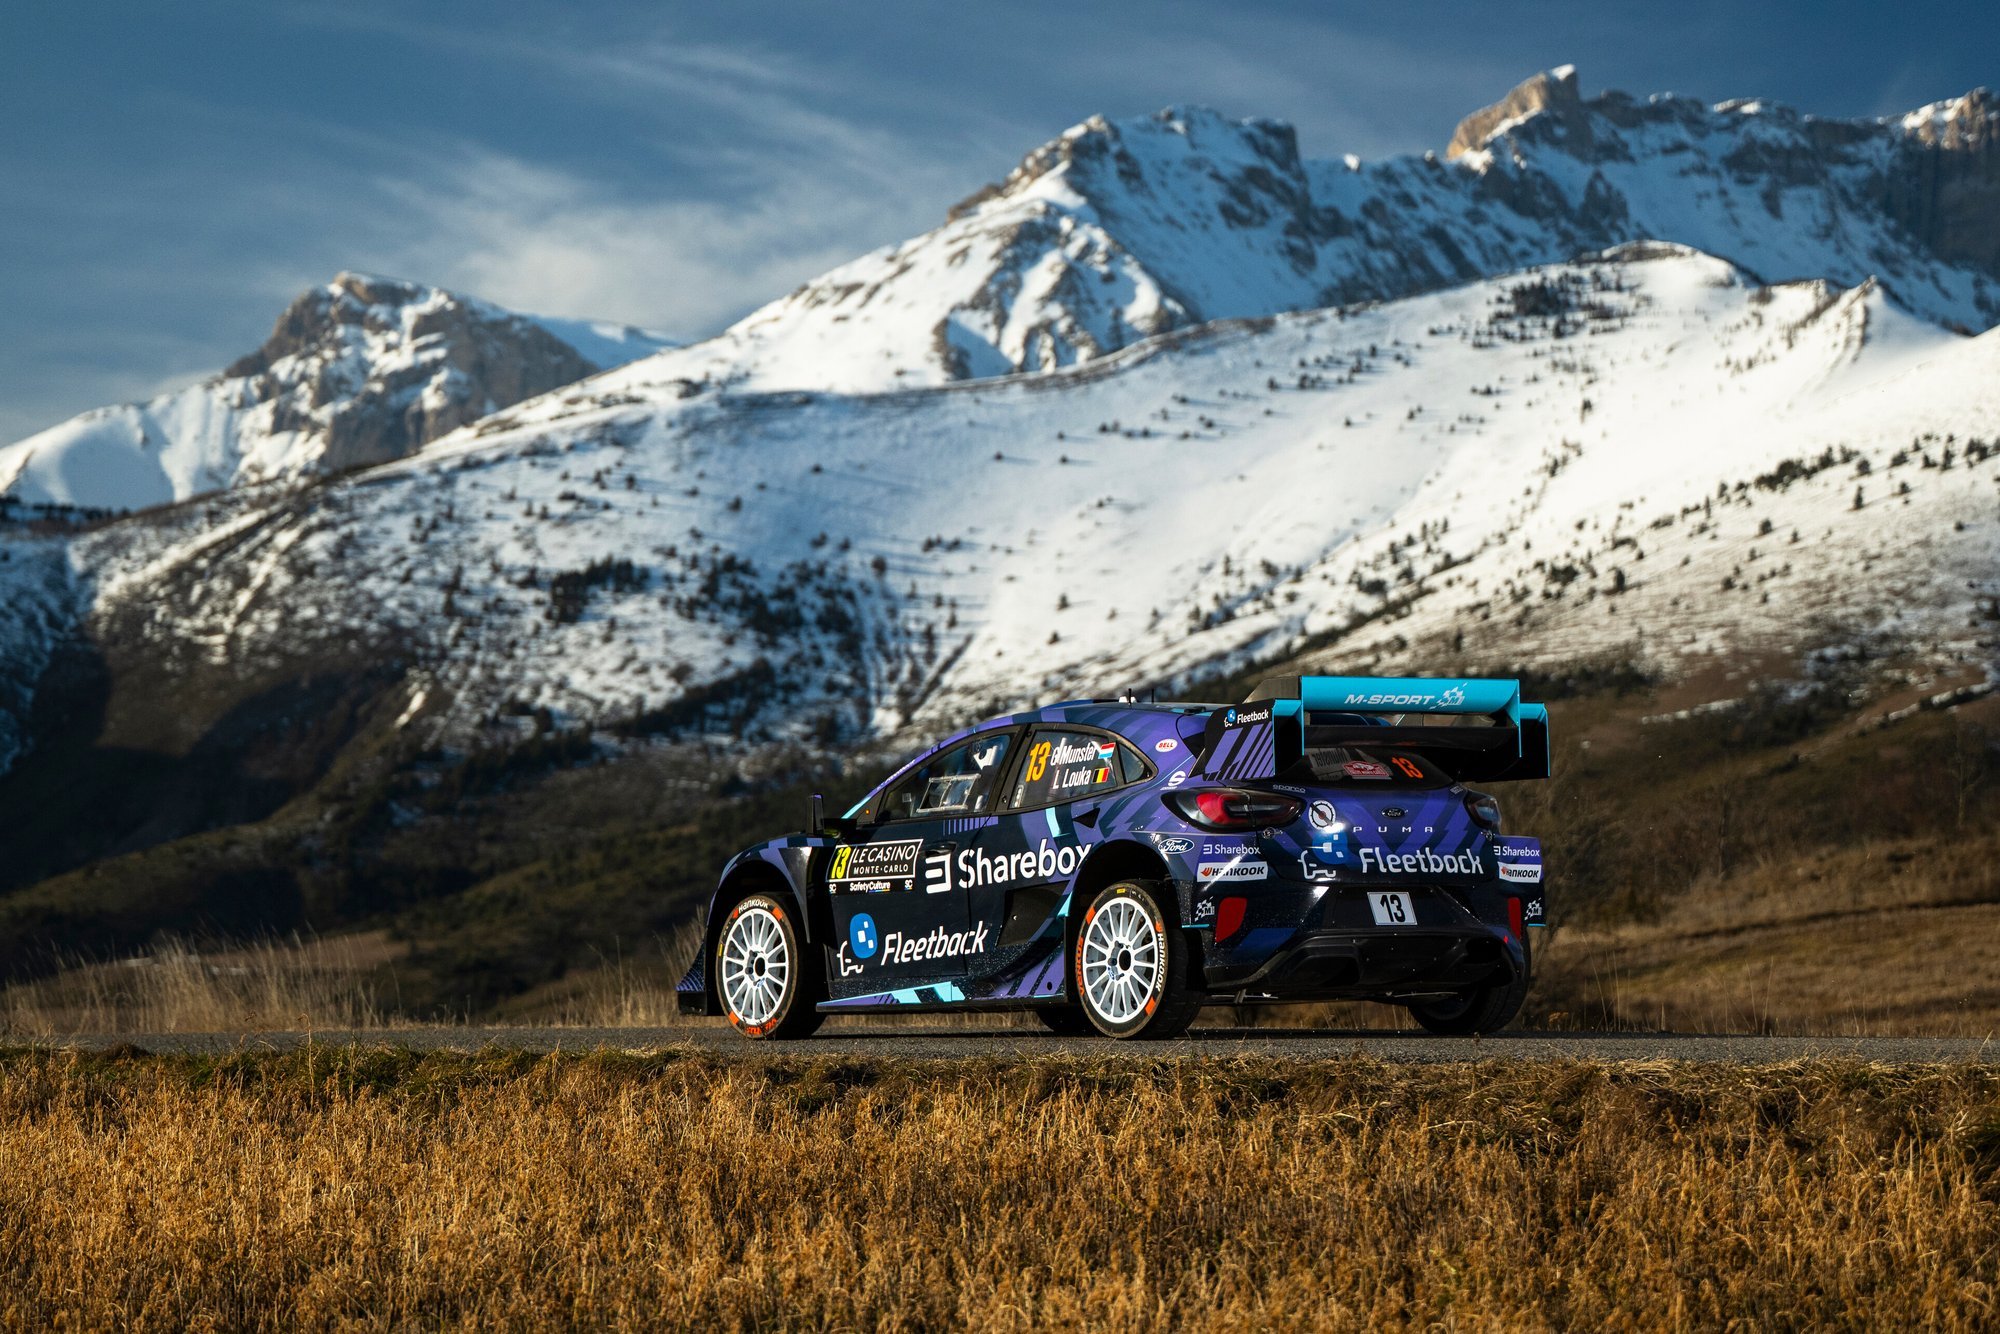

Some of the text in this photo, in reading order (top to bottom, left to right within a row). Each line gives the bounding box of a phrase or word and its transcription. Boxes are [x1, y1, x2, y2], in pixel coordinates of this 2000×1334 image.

[1344, 694, 1435, 705] M-SPORT
[1236, 709, 1269, 725] Fleetback
[1025, 741, 1052, 783] 13
[1391, 756, 1424, 779] 13
[1062, 766, 1092, 788] Louka
[852, 844, 916, 864] LE CASINO
[1163, 840, 1188, 854] Ford
[1214, 843, 1261, 855] Sharebox
[1502, 846, 1540, 857] Sharebox
[830, 846, 852, 879] 13
[1358, 847, 1484, 875] Fleetback
[849, 880, 891, 893] SafetyCulture
[1379, 894, 1406, 923] 13
[880, 920, 989, 966] Fleetback
